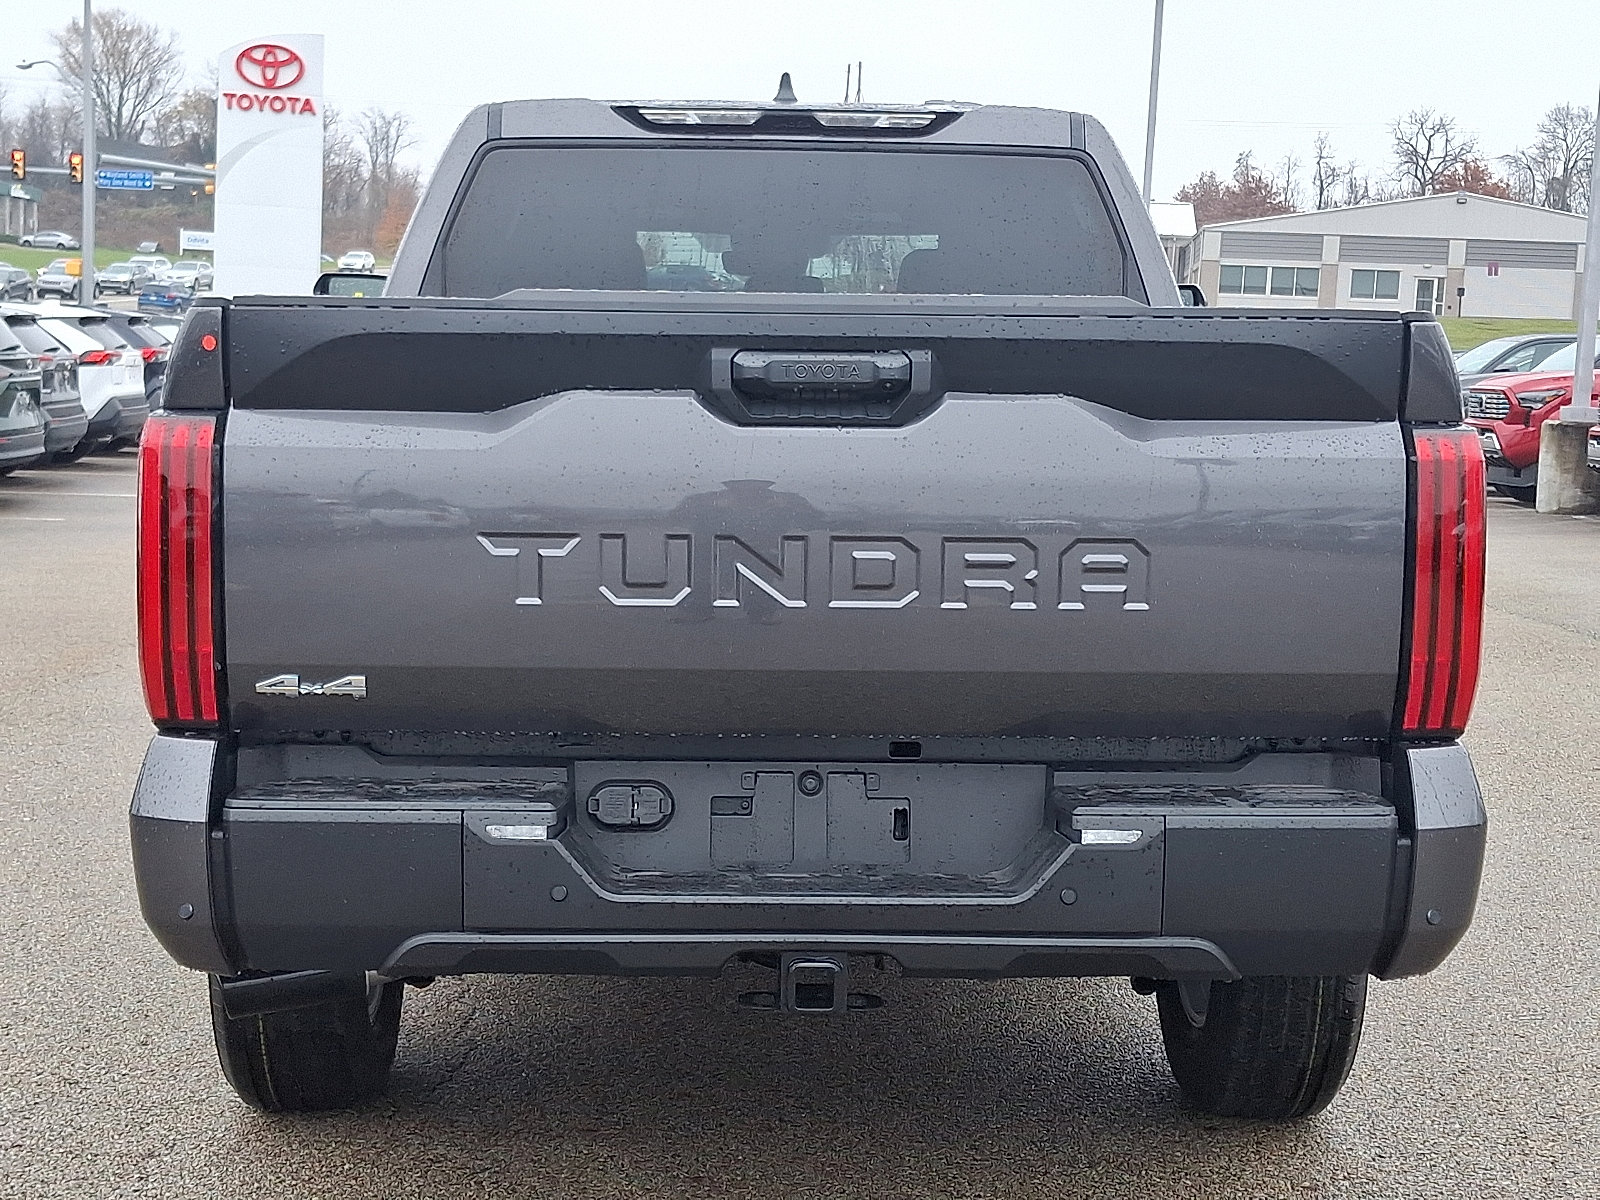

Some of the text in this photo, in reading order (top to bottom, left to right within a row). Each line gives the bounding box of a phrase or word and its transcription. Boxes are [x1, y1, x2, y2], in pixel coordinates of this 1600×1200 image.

[223, 93, 316, 116] TOYOTA
[781, 363, 860, 379] TOYOTA
[476, 531, 1151, 610] TUNDRA
[255, 674, 366, 698] 4x4
